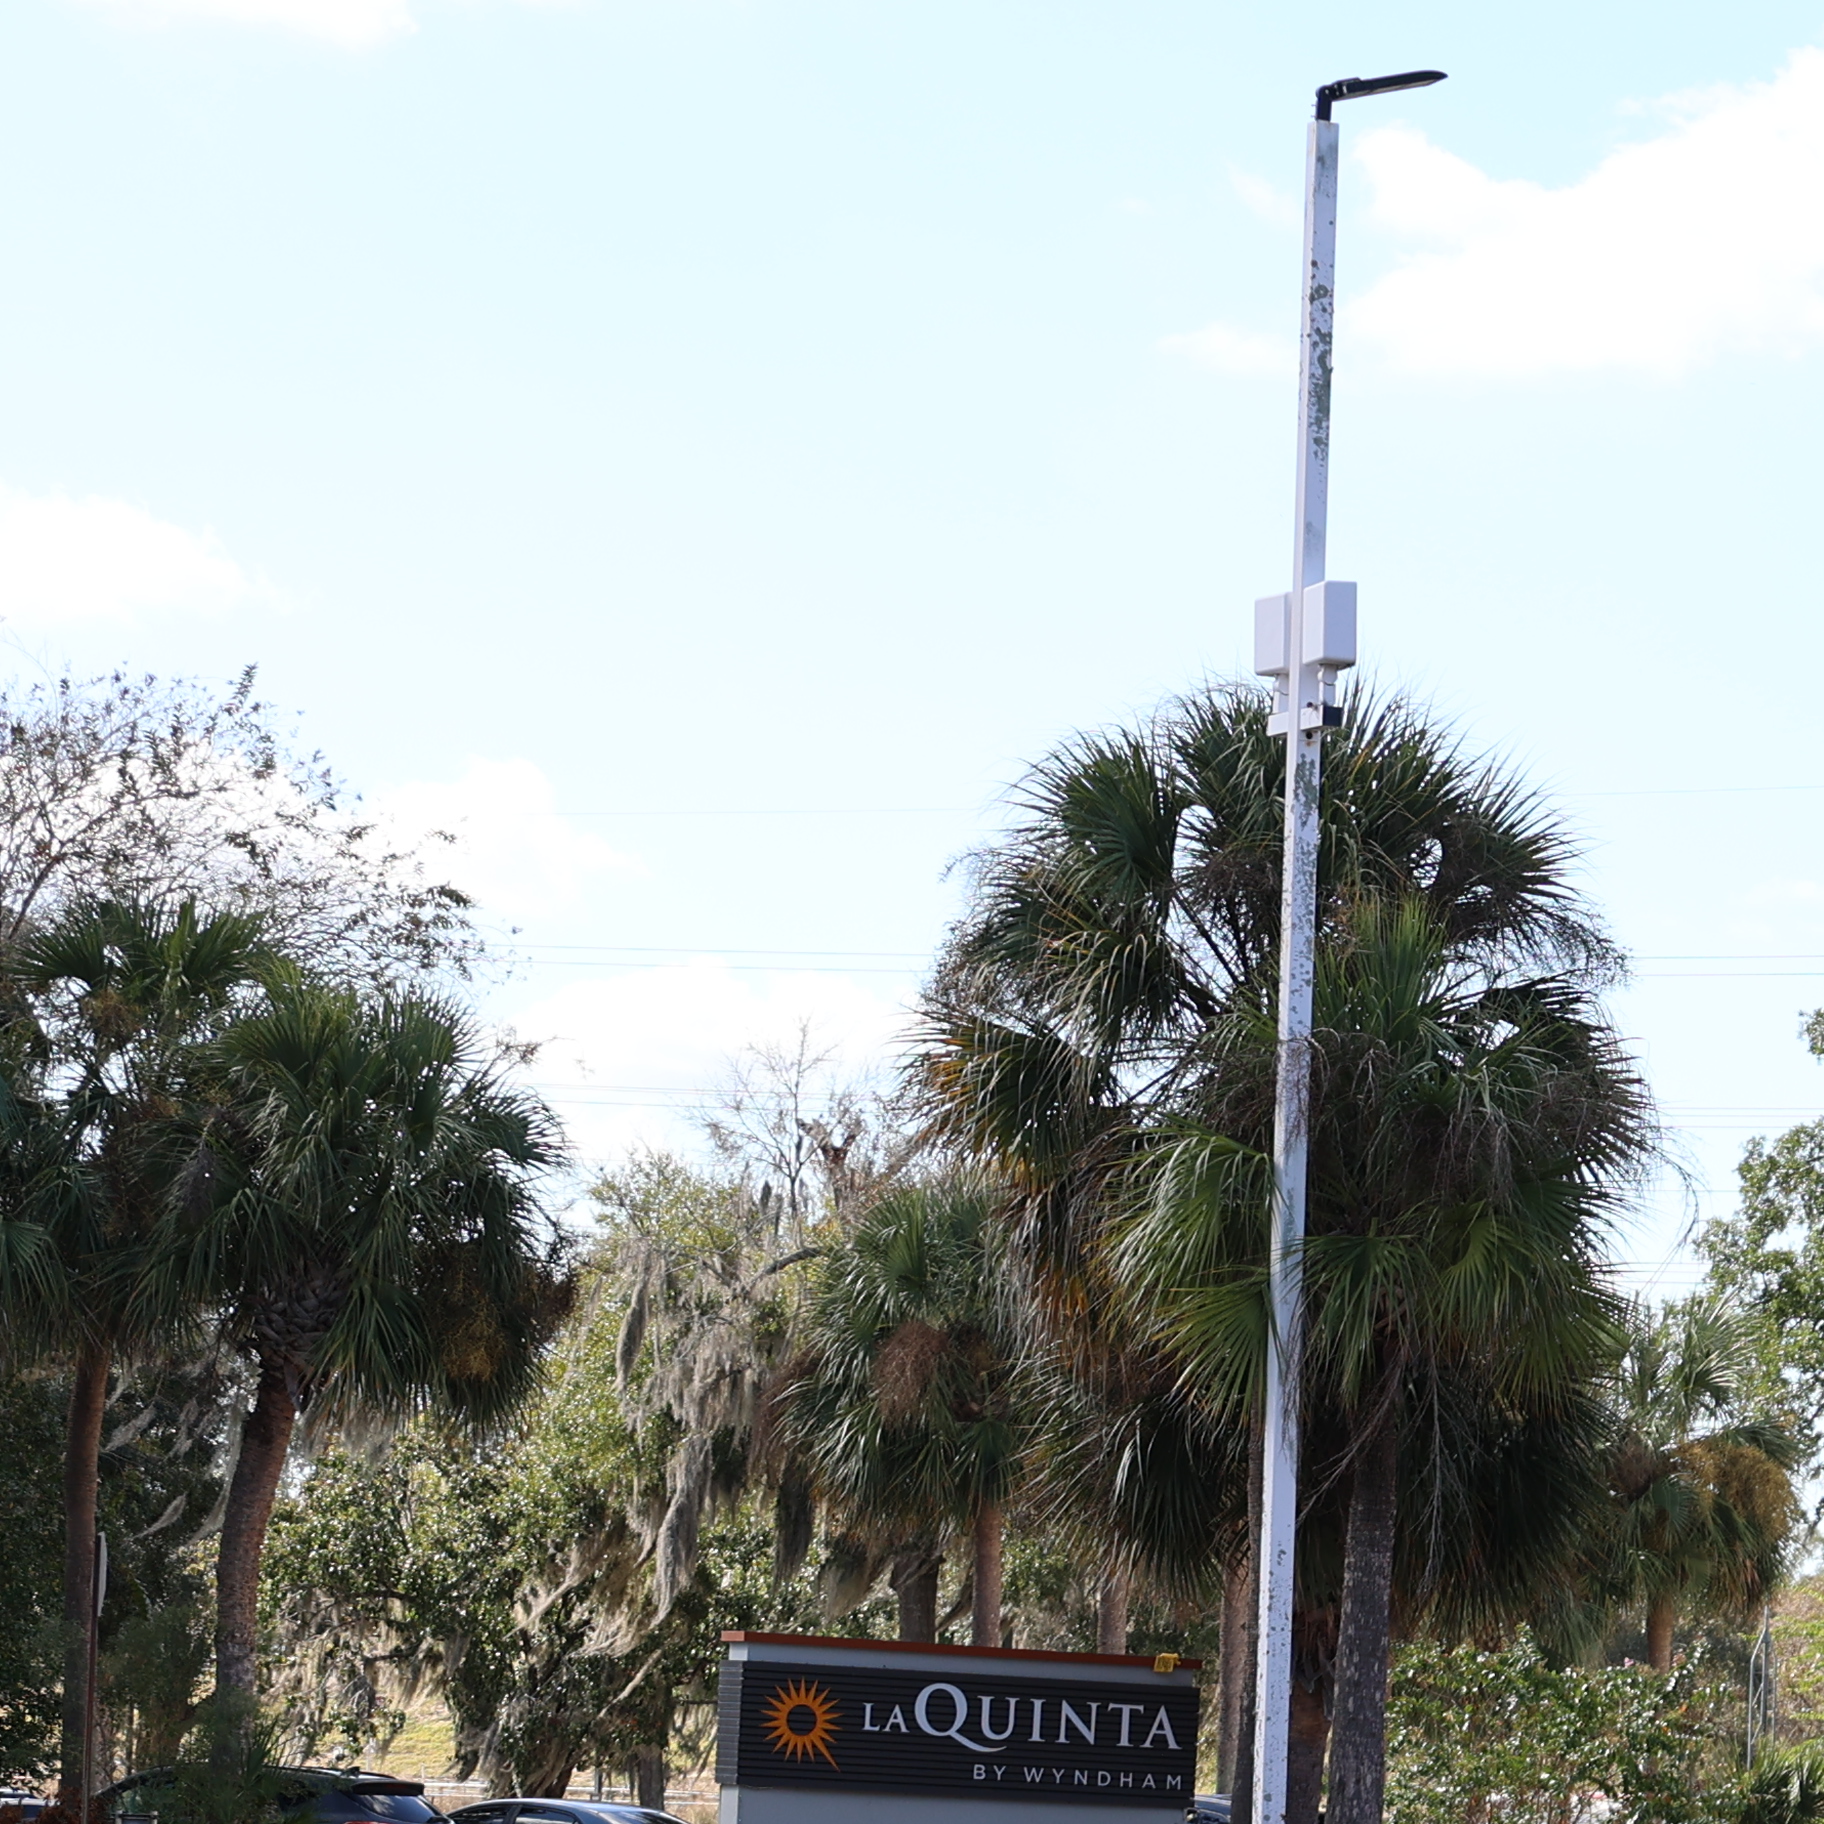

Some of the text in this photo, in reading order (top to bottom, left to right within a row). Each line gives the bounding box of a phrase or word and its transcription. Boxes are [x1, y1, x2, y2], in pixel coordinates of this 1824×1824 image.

[862, 1682, 1182, 1752] LA QUINTA
[973, 1764, 1182, 1790] BY WYNDHAM
